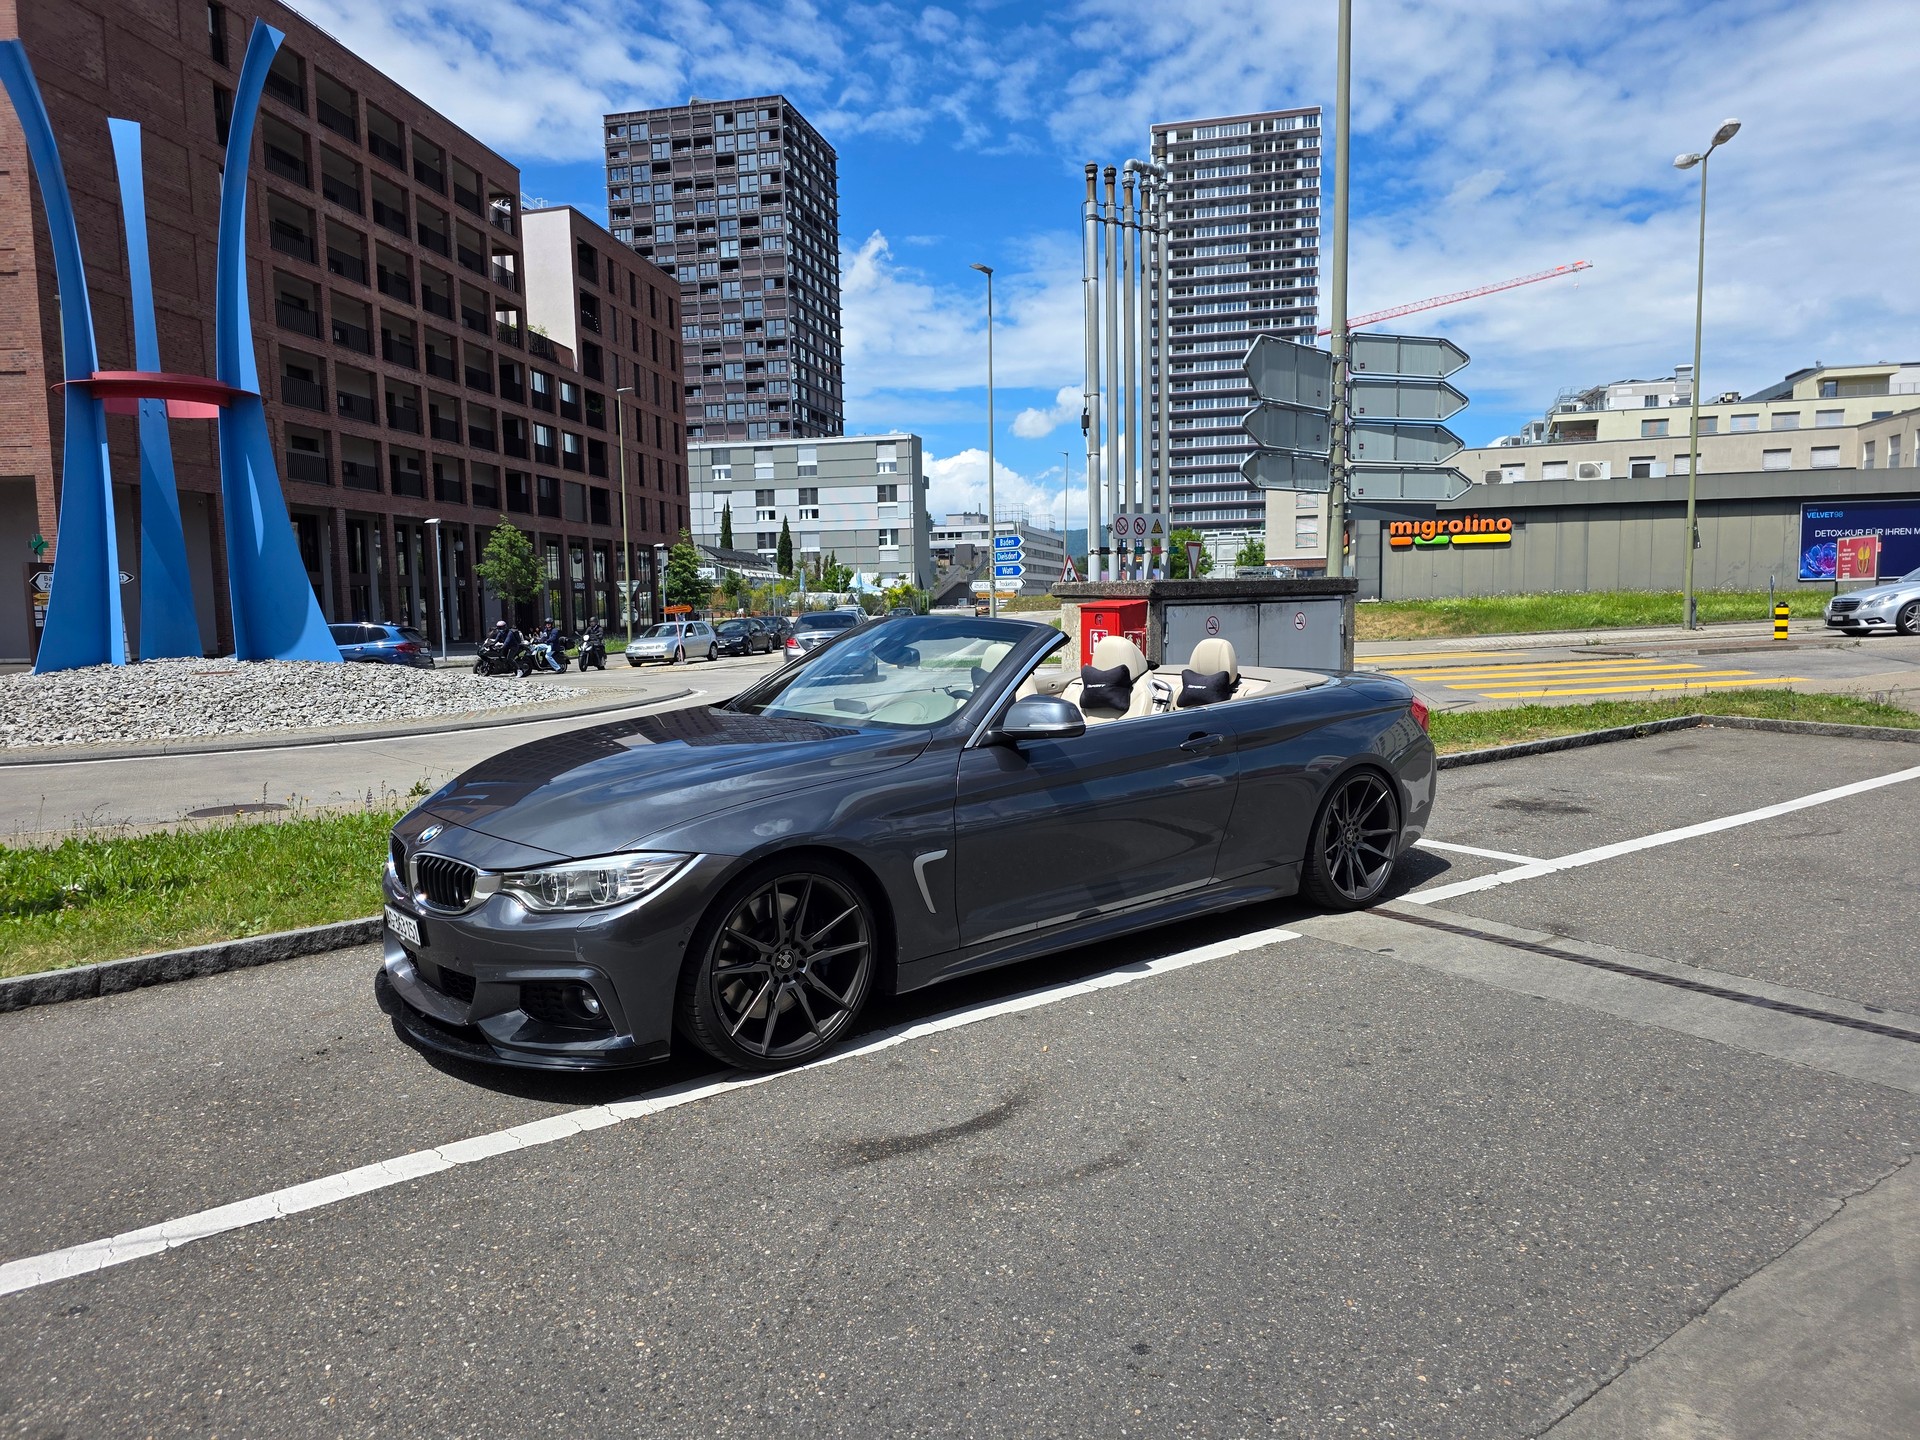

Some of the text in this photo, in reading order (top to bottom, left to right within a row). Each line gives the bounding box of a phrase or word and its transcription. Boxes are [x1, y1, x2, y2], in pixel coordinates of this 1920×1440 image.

[1807, 511, 1844, 519] VELVET98
[1389, 513, 1513, 540] migrolino
[1814, 529, 1863, 538] DETOX-KUR
[1885, 527, 1912, 536] IHREN
[1000, 538, 1014, 546] Baden
[997, 551, 1018, 561] Dielsdorf
